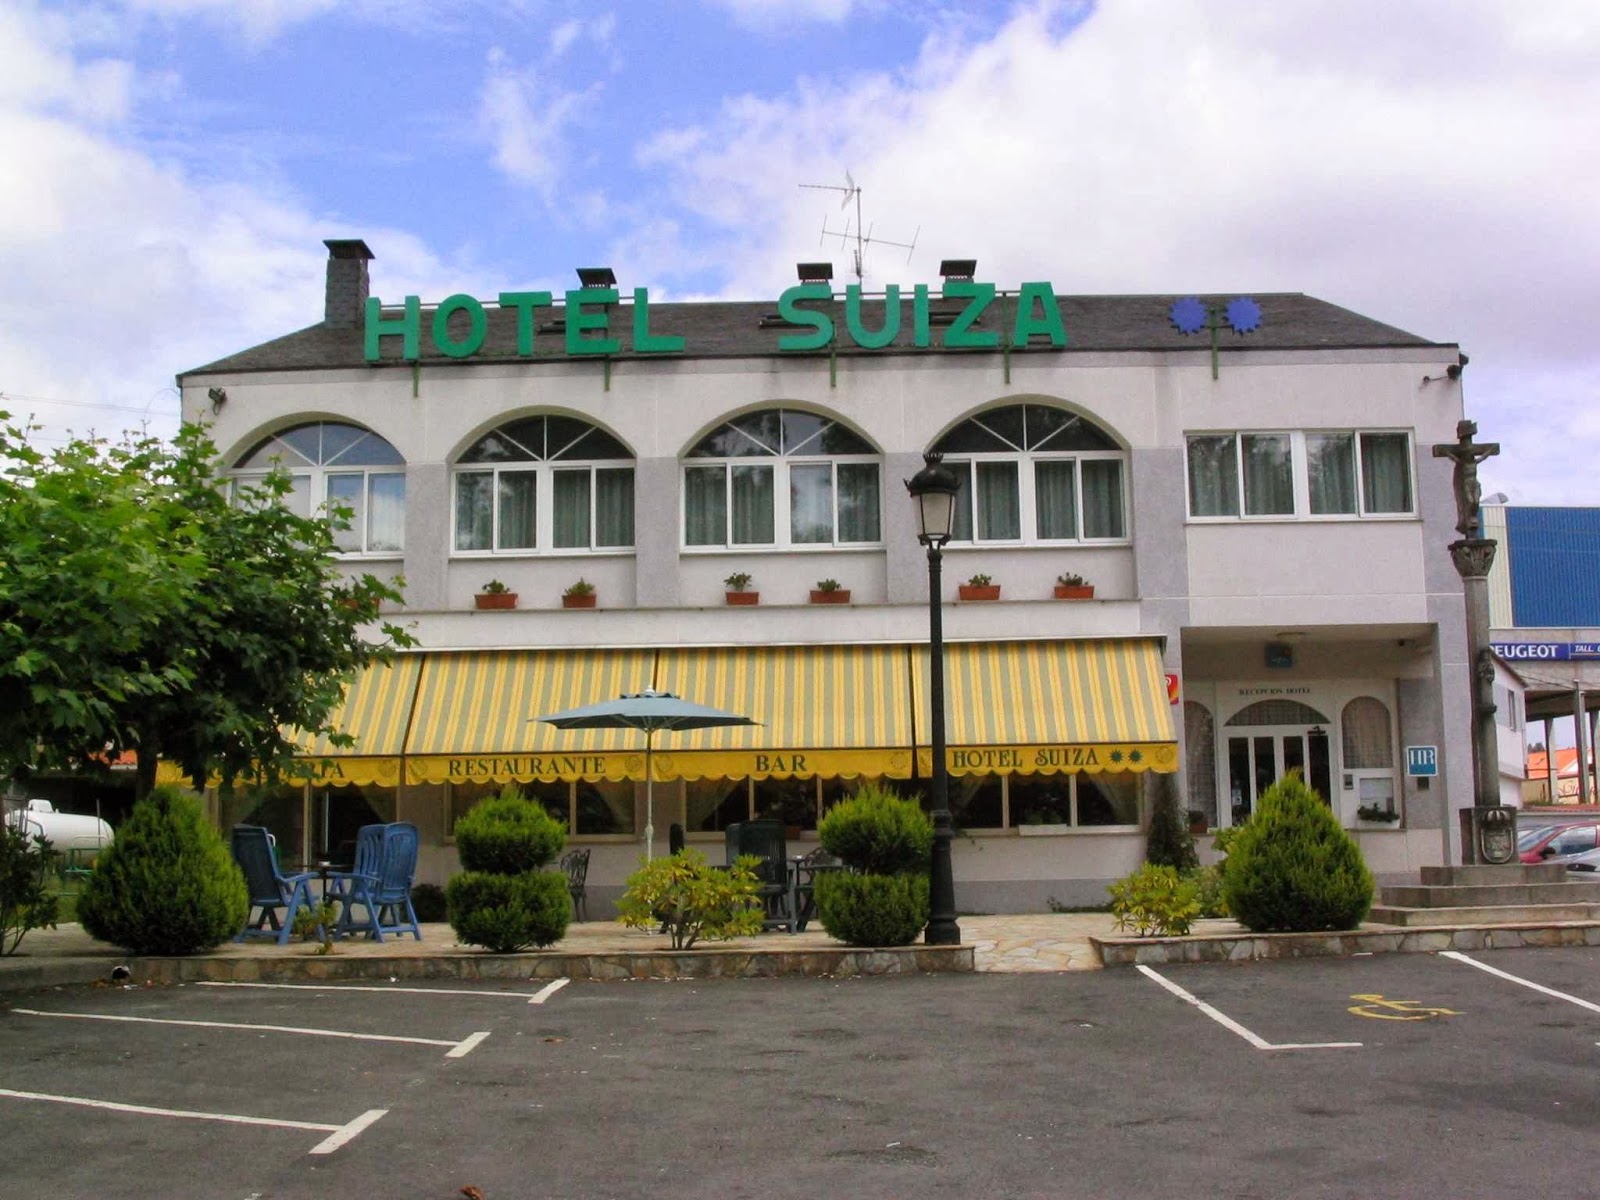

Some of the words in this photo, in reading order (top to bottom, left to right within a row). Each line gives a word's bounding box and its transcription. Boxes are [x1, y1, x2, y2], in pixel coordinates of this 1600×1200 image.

[364, 286, 685, 361] HOTEL
[776, 281, 1067, 352] SUIZA
[1489, 644, 1558, 658] EUGEOT
[449, 756, 607, 777] RESTAURANTE
[755, 754, 807, 772] BAR
[953, 749, 1023, 768] HOTEL
[1034, 747, 1099, 766] SUIZA
